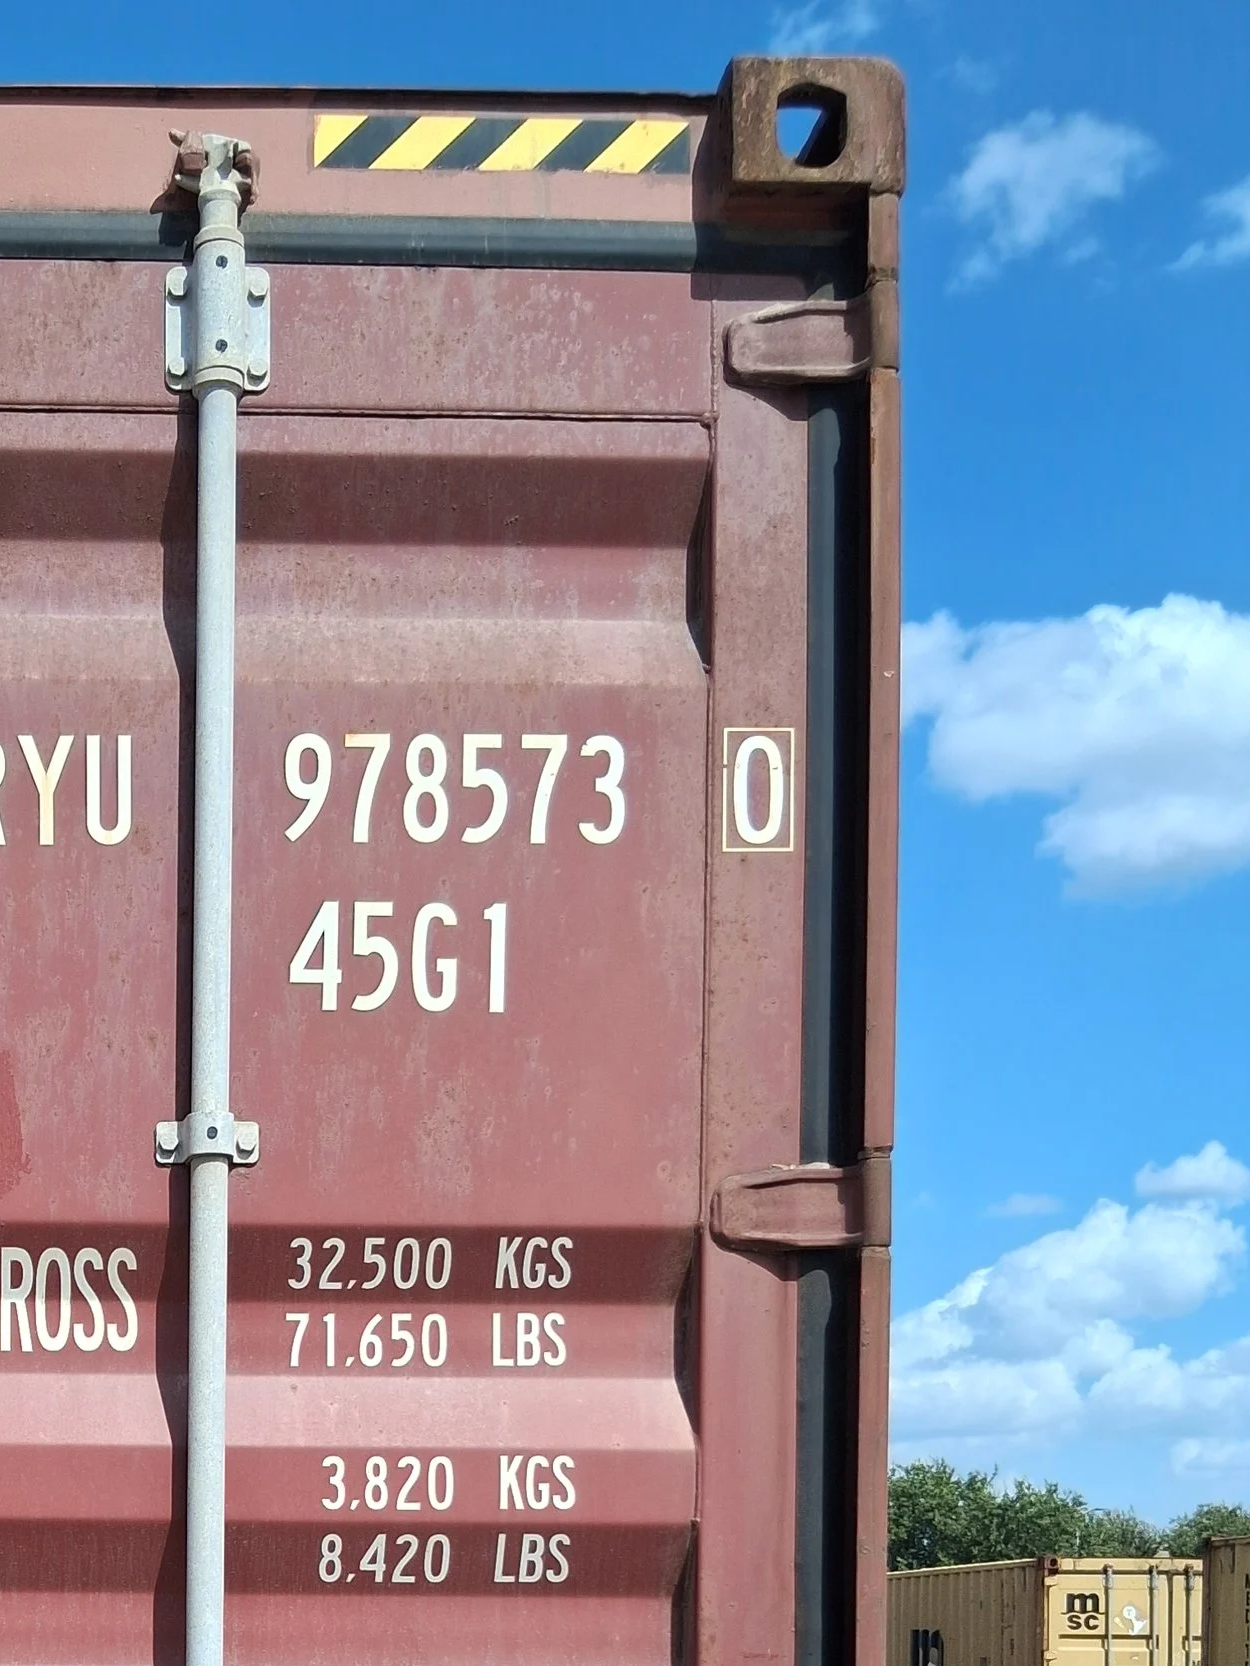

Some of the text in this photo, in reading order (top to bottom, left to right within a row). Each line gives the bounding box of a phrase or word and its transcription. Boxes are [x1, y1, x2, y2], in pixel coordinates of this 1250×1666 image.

[284, 733, 626, 845] 978573
[732, 735, 784, 845] 0
[289, 901, 507, 1014] 45G1
[287, 1236, 574, 1290] 32,500 KGS
[285, 1311, 568, 1368] 71,650 LBS
[321, 1455, 577, 1511] 3,820 KGS
[318, 1533, 571, 1584] 8,420 LBS
